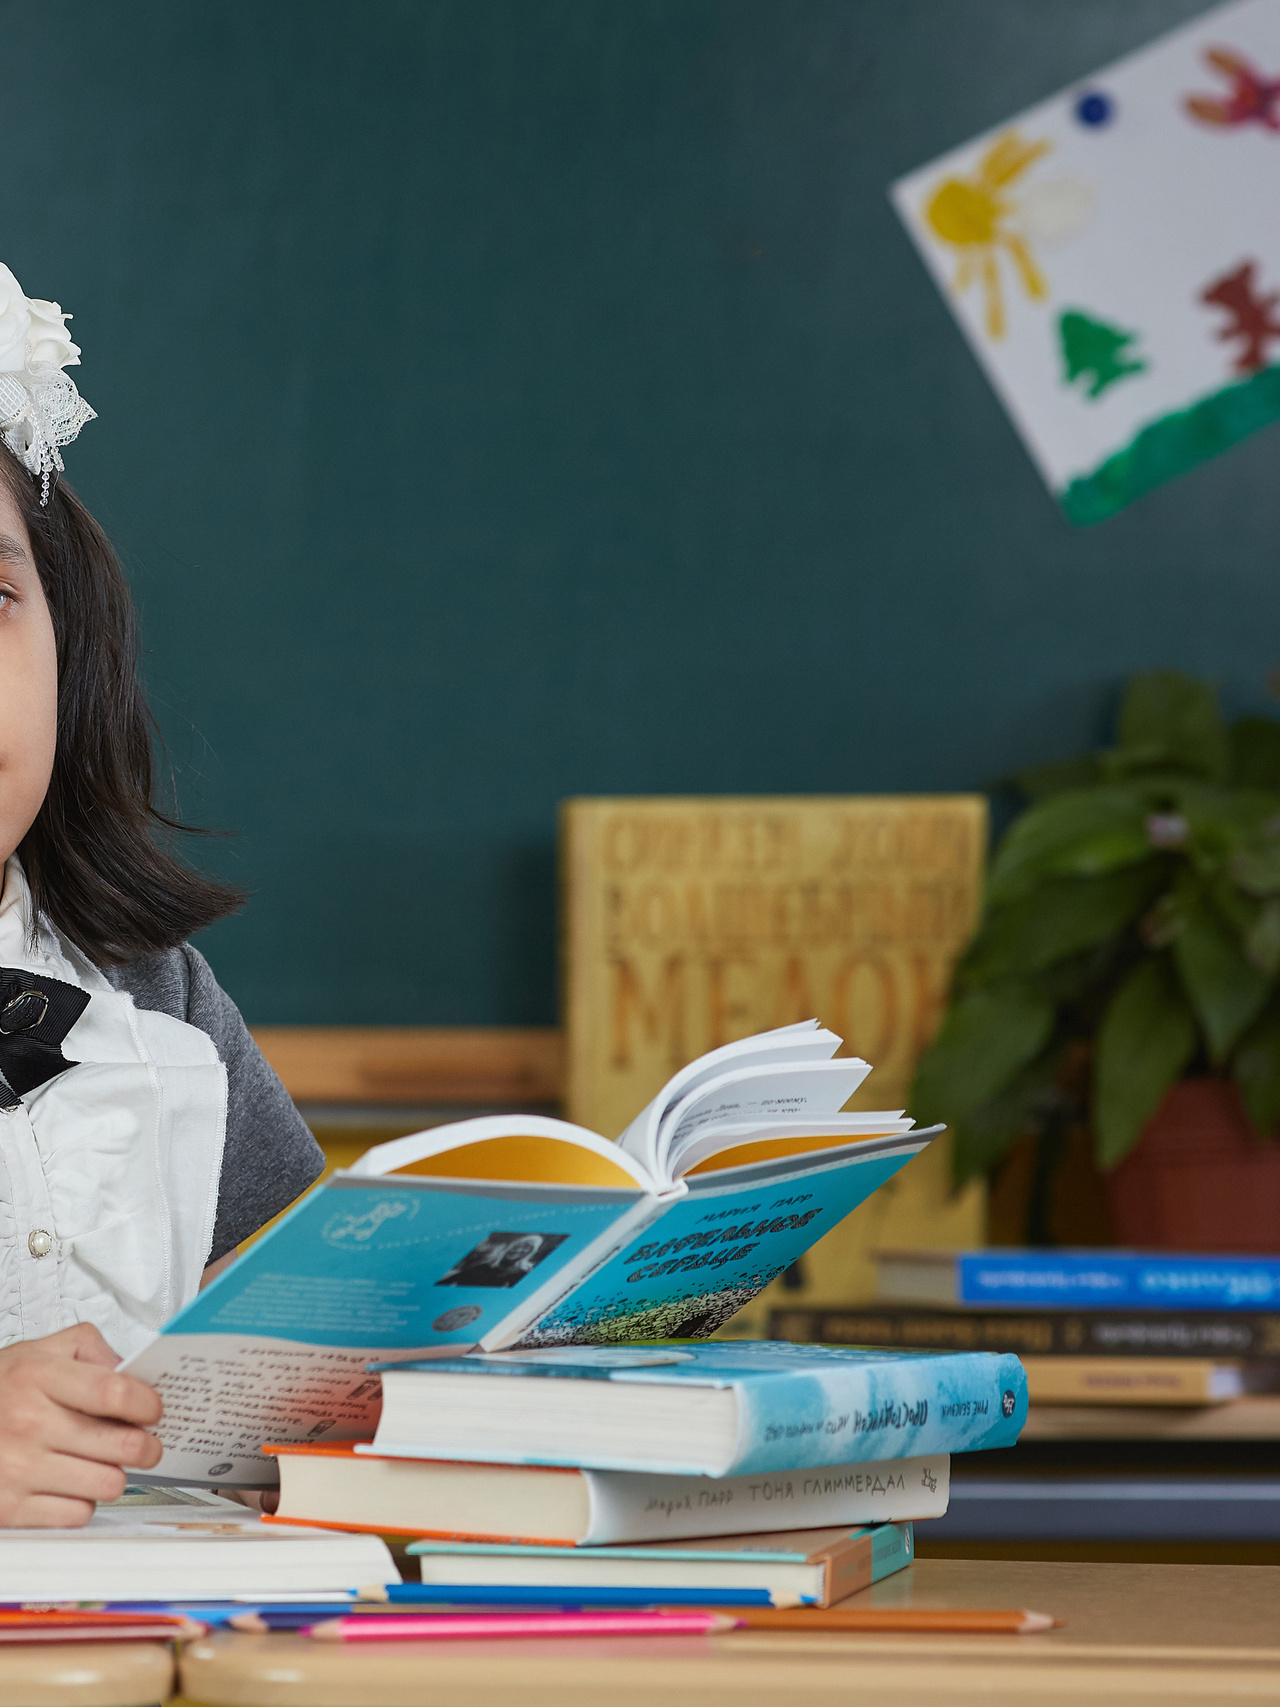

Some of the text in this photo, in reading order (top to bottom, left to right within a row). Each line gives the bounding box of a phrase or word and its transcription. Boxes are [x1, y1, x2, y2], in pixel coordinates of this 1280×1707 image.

[695, 1194, 813, 1224] МАРИЯ ПАРР
[623, 1208, 823, 1265] ВАФЕЛЬНОЕ
[626, 1242, 760, 1283] СЕРДЦЕ
[749, 1484, 795, 1502] ТОНЯ
[803, 1474, 906, 1497] ГЛИММЕРДАЛ
